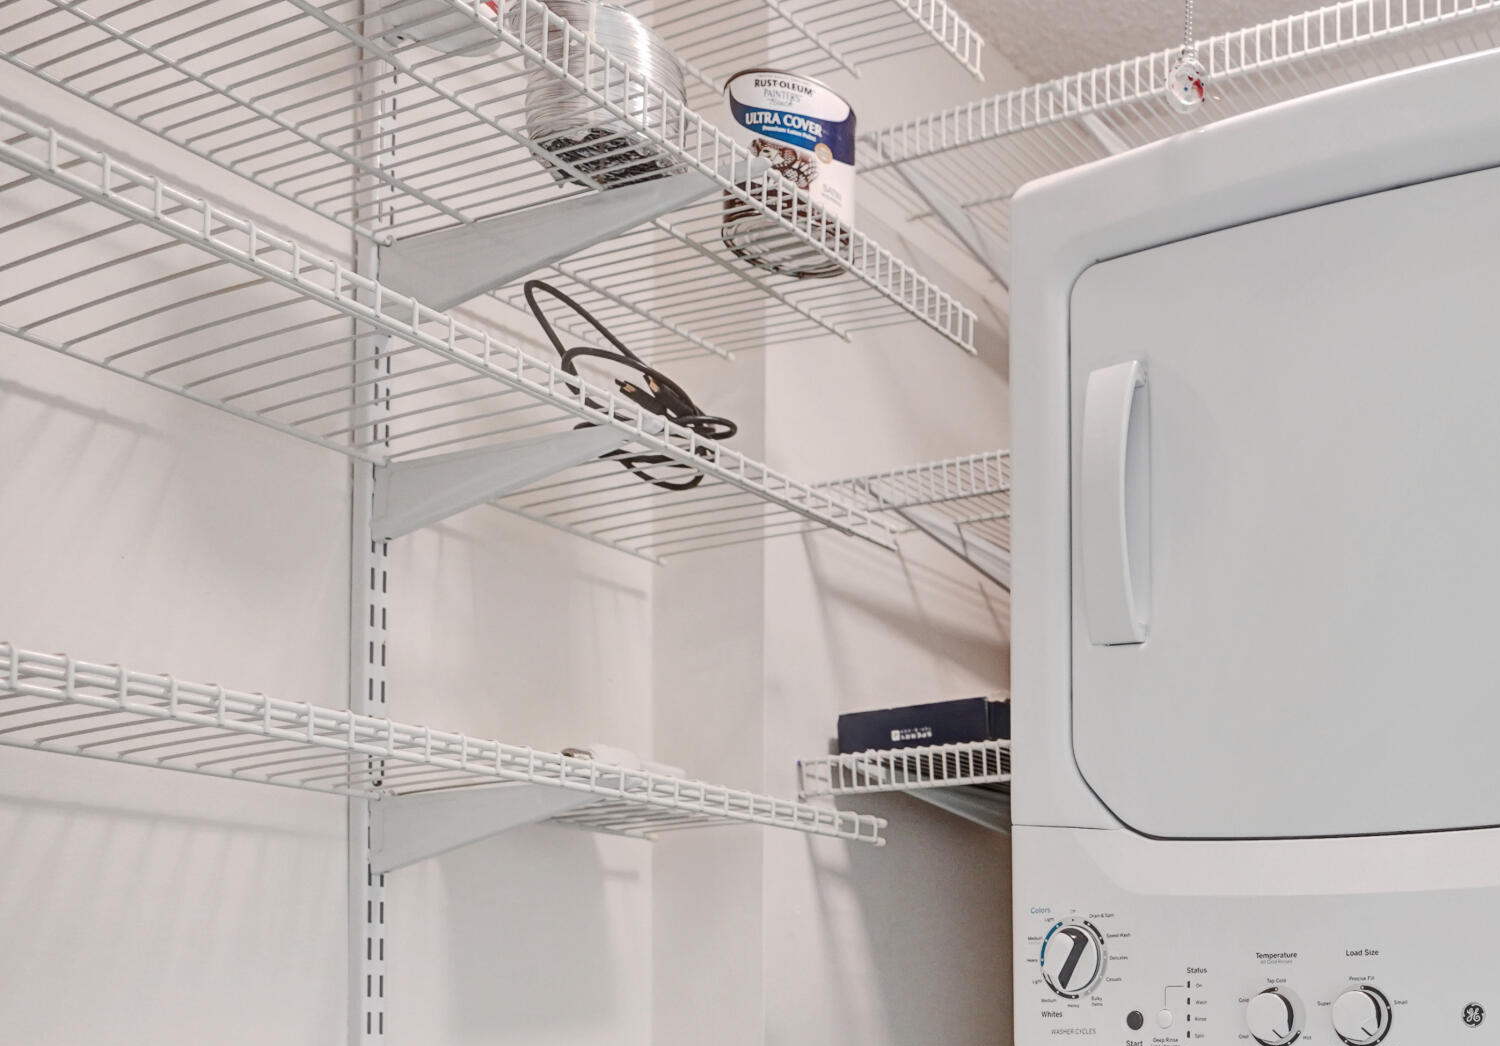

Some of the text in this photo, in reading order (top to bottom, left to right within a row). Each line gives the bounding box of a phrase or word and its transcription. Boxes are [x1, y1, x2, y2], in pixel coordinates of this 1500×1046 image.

[745, 112, 823, 138] ULTRA COVER
[1345, 949, 1362, 957] Load
[1075, 1027, 1096, 1035] CYCLES
